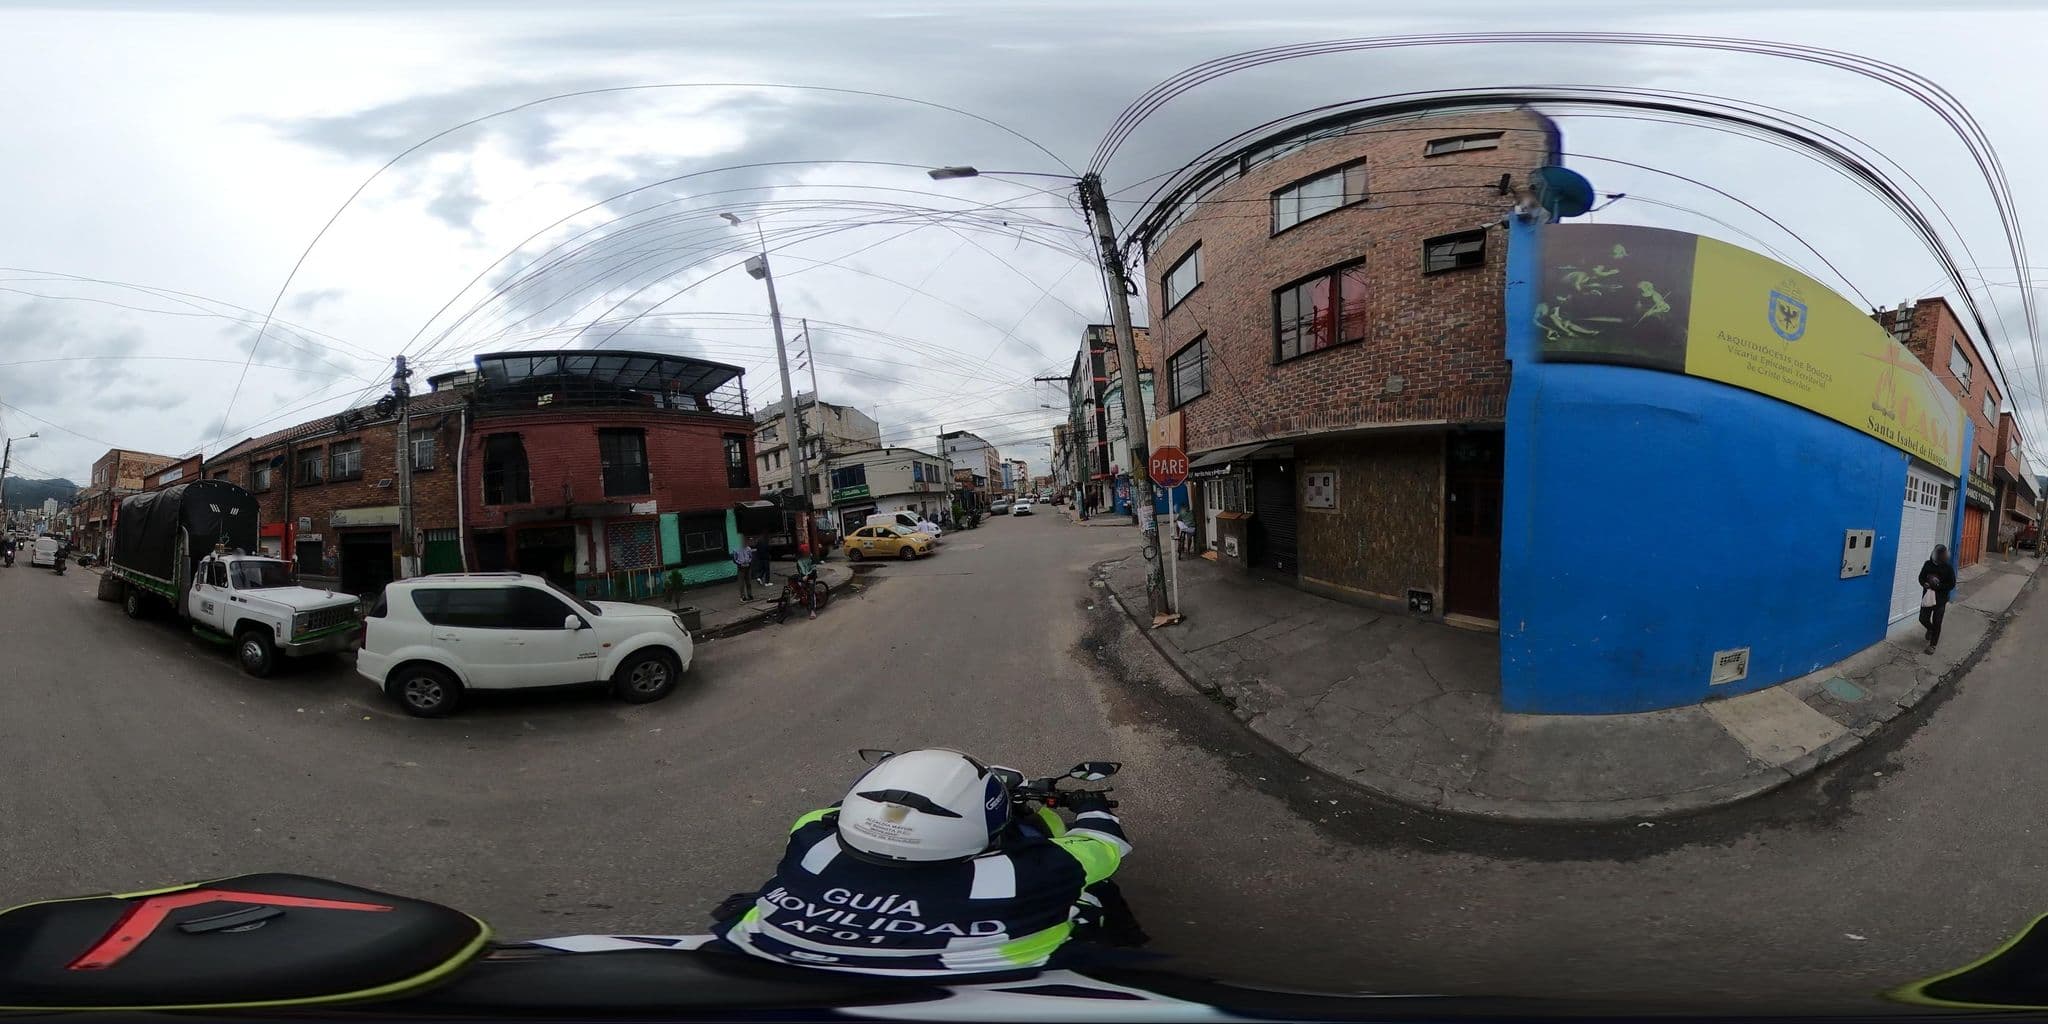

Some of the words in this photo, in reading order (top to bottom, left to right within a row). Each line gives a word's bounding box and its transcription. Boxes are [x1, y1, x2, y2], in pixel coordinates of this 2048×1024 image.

[1746, 361, 1756, 371] de
[1757, 366, 1780, 381] Cristo
[1867, 415, 1894, 440] Santa
[1897, 430, 1919, 452] Isabel
[1919, 445, 1927, 457] de
[1899, 394, 1949, 456] CASA
[1152, 459, 1185, 475] PARE
[766, 887, 1007, 936] MOVILIDAD
[822, 888, 921, 917] GUÍA
